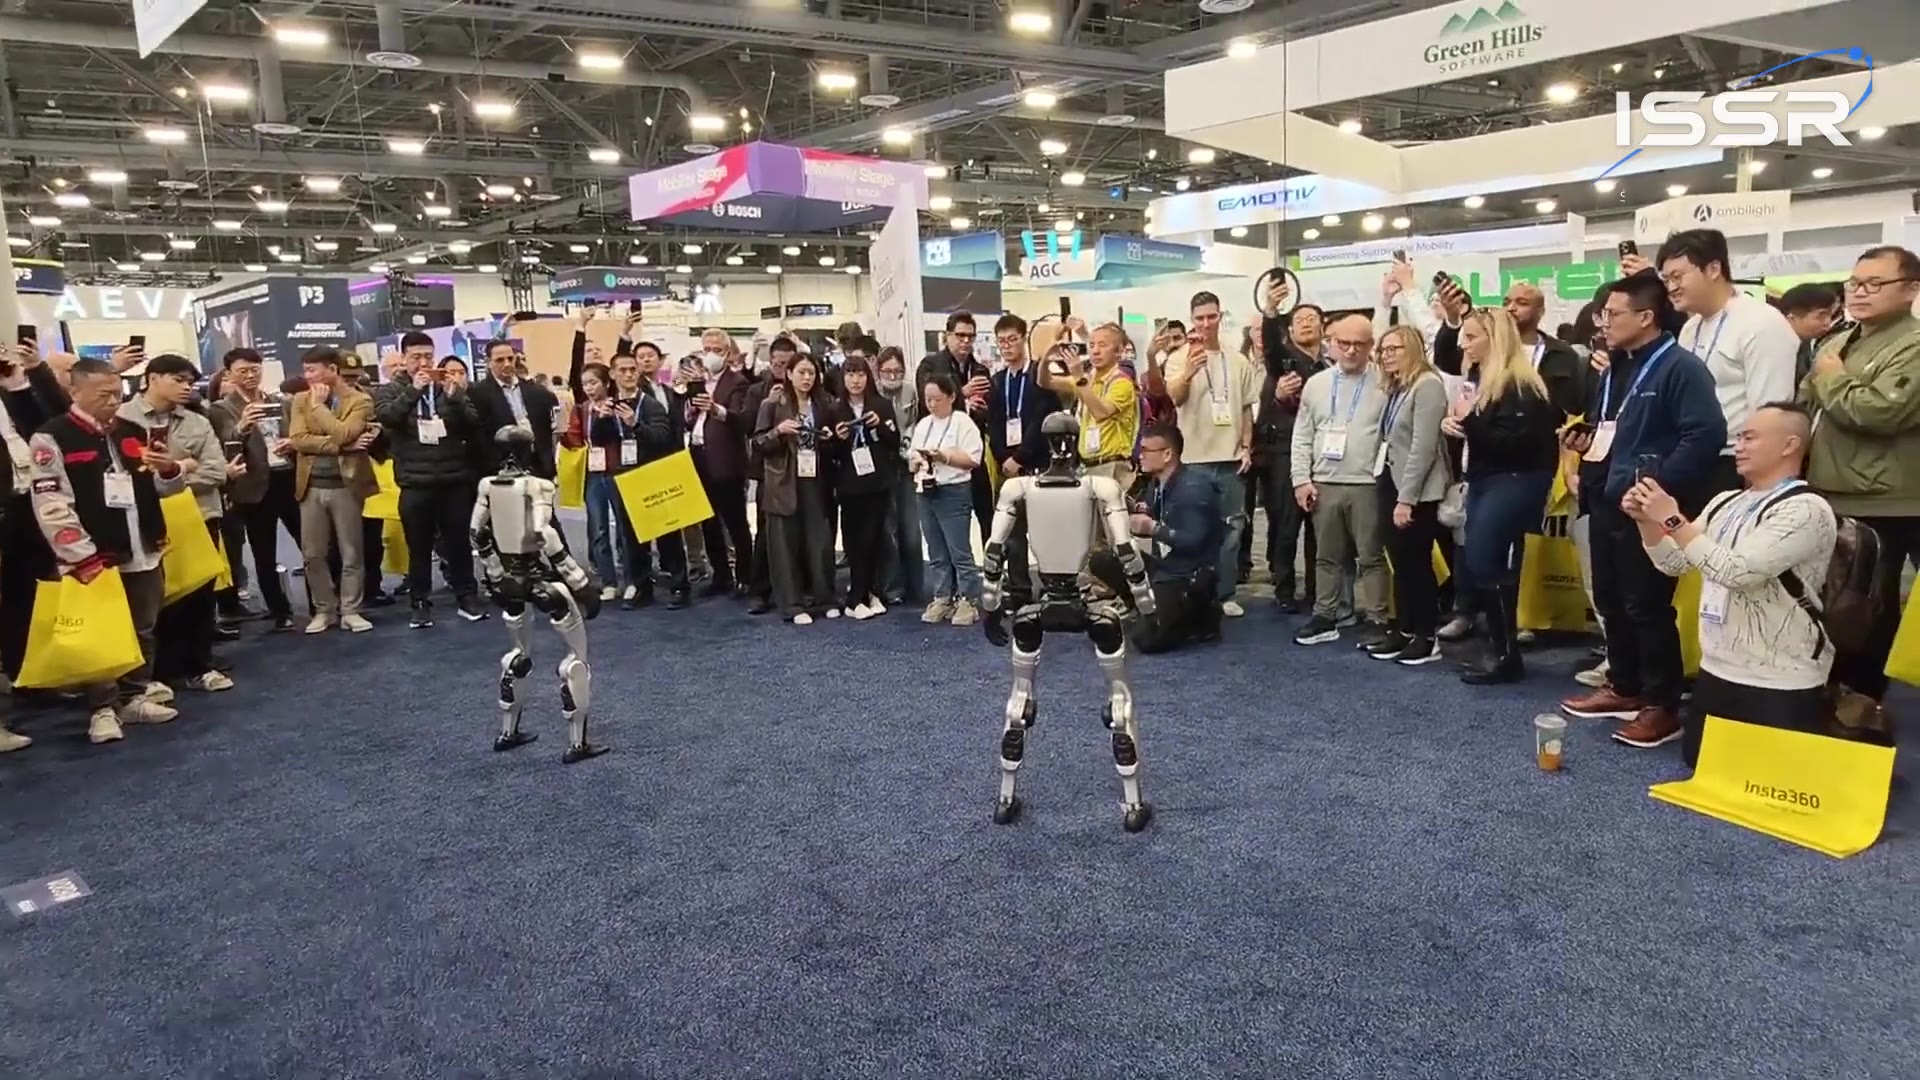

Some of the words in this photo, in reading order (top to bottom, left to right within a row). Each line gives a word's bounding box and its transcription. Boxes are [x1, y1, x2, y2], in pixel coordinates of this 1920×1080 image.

[1424, 39, 1485, 64] Green
[1491, 24, 1543, 50] Hills
[1439, 47, 1526, 74] SOFTWARE
[1218, 185, 1317, 211] EMOTIV
[727, 204, 762, 218] BOSCH
[1716, 204, 1776, 217] ambilight
[1416, 240, 1455, 252] Mobility
[1030, 261, 1062, 279] AGC
